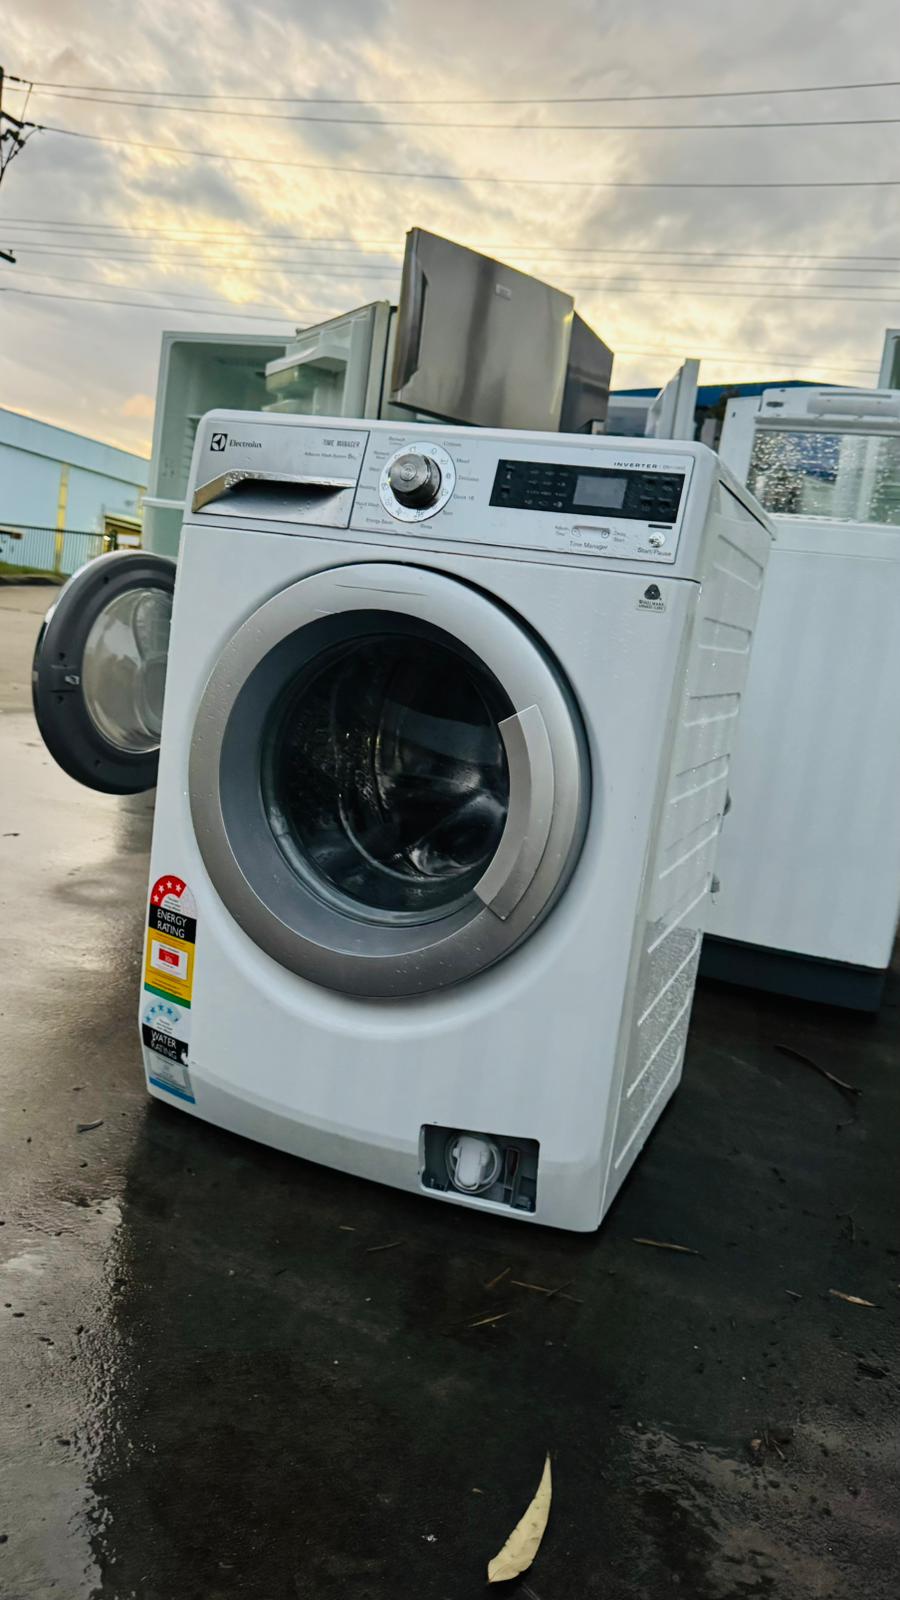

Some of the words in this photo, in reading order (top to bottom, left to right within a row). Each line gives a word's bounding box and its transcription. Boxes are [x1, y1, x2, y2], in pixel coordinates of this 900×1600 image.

[229, 438, 262, 449] Electrolux
[613, 461, 658, 469] INVERTER
[583, 541, 609, 551] Manager
[157, 908, 188, 927] ENERGY
[157, 920, 185, 939] RATING
[151, 1029, 177, 1050] WATER
